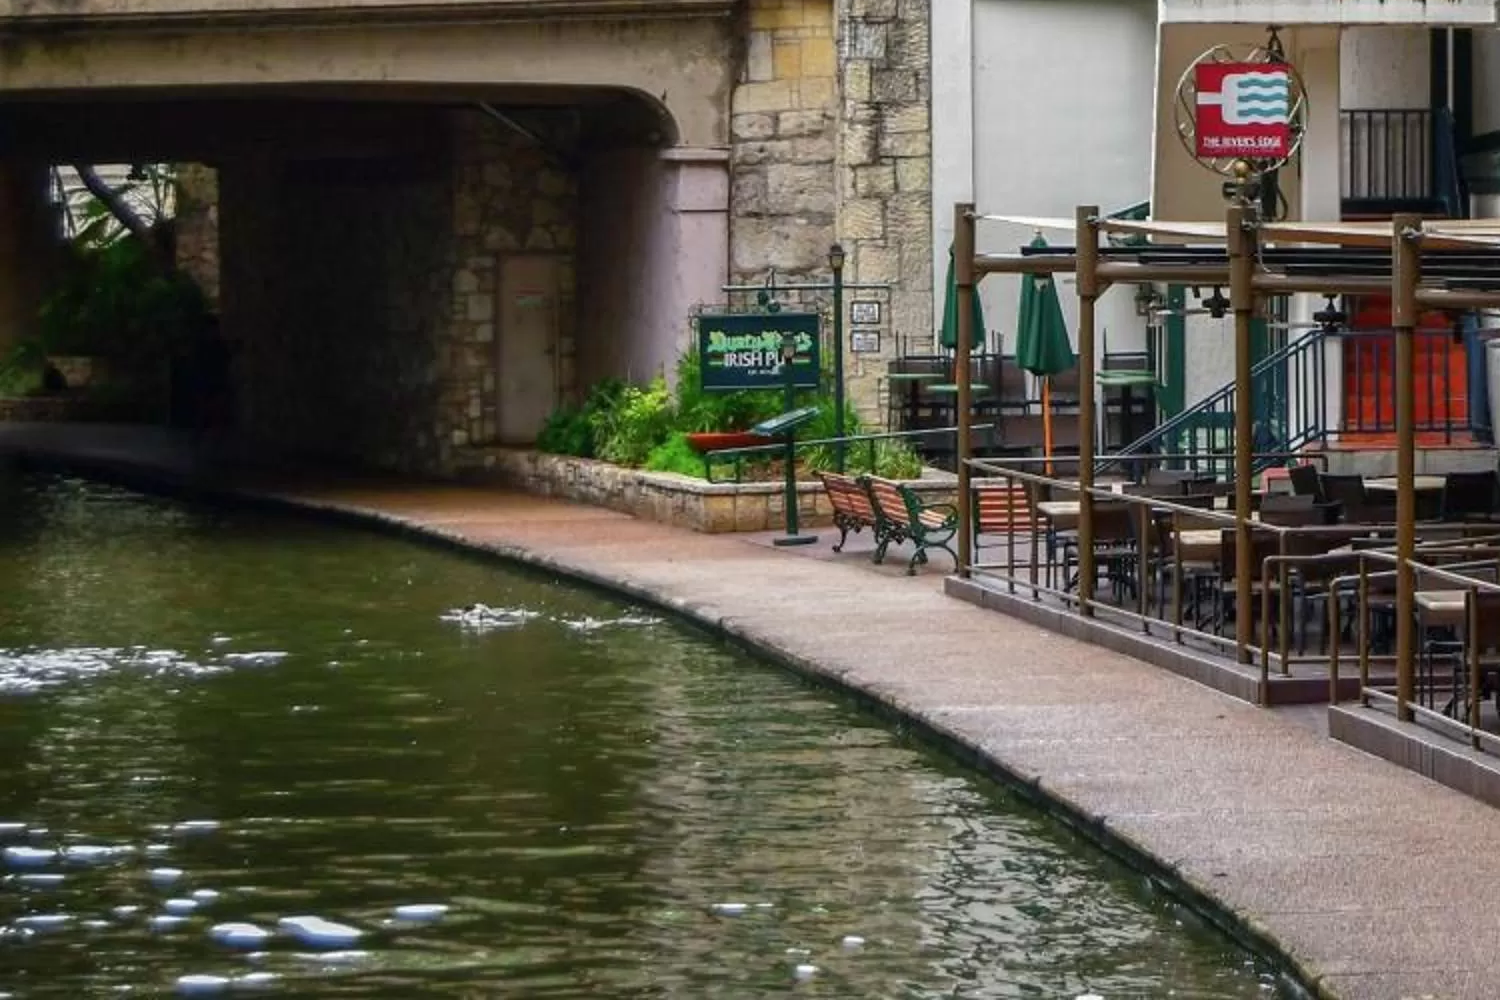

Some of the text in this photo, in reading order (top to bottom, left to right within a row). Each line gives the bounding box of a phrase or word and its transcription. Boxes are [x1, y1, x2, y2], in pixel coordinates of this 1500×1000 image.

[1203, 136, 1219, 147] THE
[724, 350, 788, 368] IRISH PU
